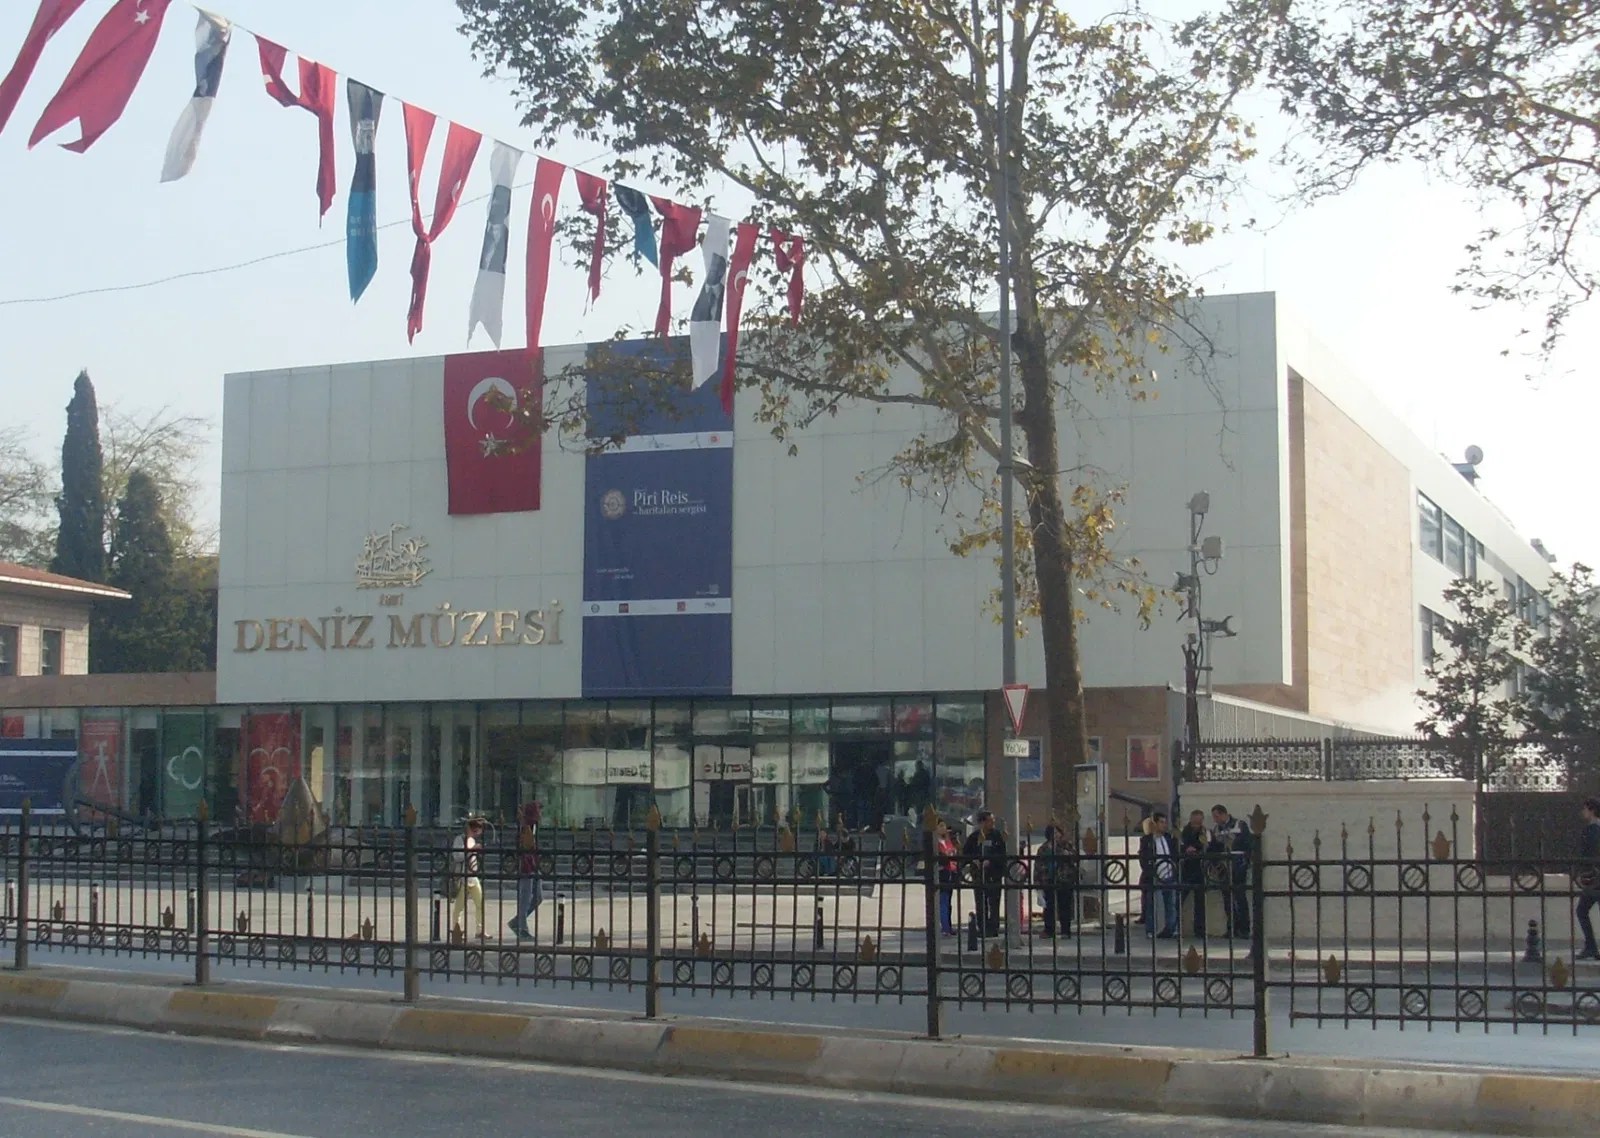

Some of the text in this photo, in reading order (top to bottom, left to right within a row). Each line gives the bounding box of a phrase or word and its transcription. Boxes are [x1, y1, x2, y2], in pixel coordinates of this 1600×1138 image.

[634, 489, 689, 506] Piri Reis
[233, 599, 564, 653] DENİZ MÜZESİ
